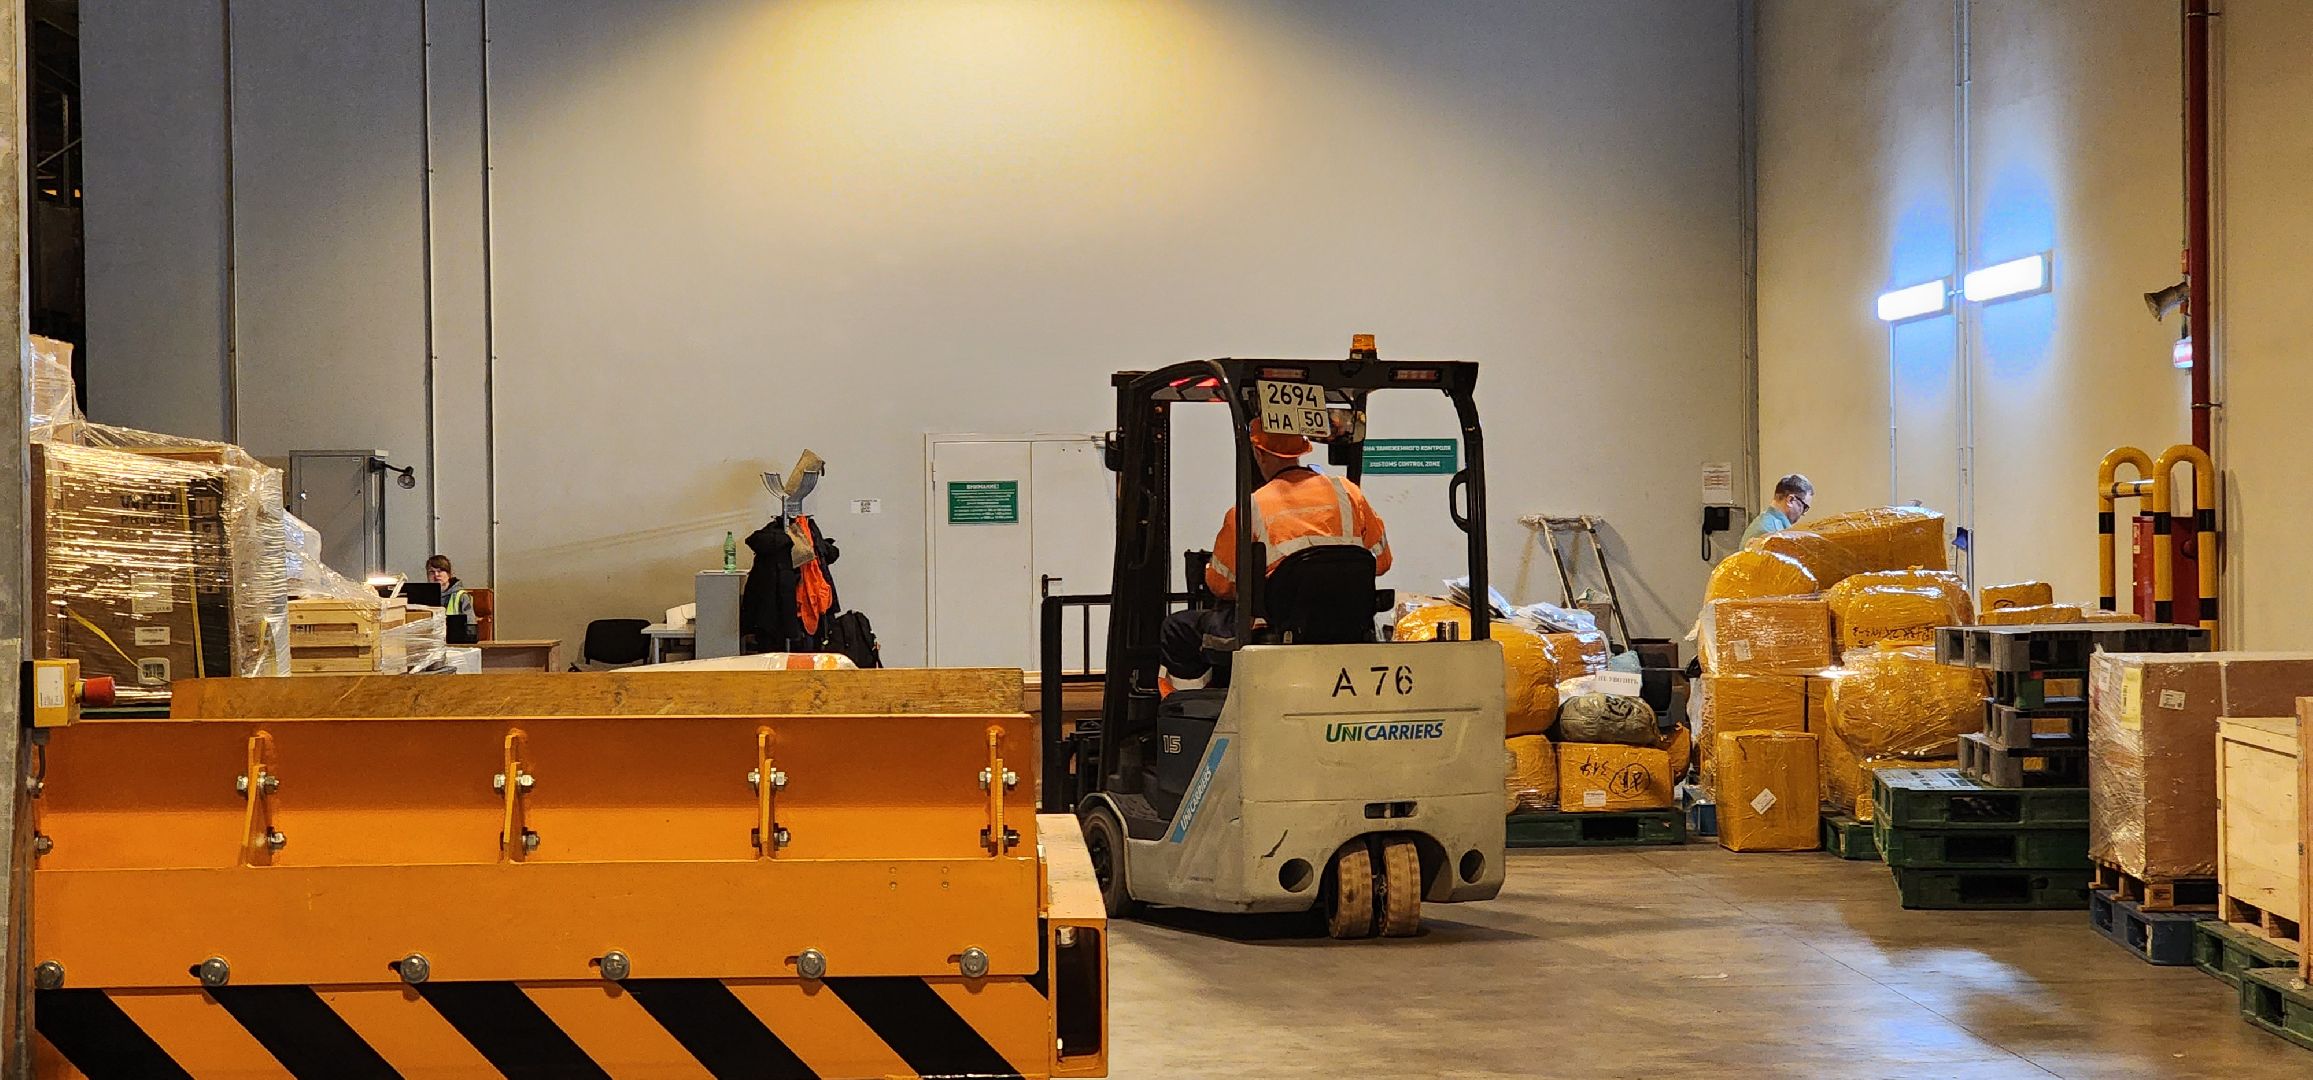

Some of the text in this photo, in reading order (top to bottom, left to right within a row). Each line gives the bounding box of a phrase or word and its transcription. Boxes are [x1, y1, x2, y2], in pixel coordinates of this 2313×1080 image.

[1267, 382, 1318, 408] 2694
[1267, 410, 1324, 431] НА 50
[1370, 665, 1413, 696] 76
[1163, 735, 1181, 754] 15
